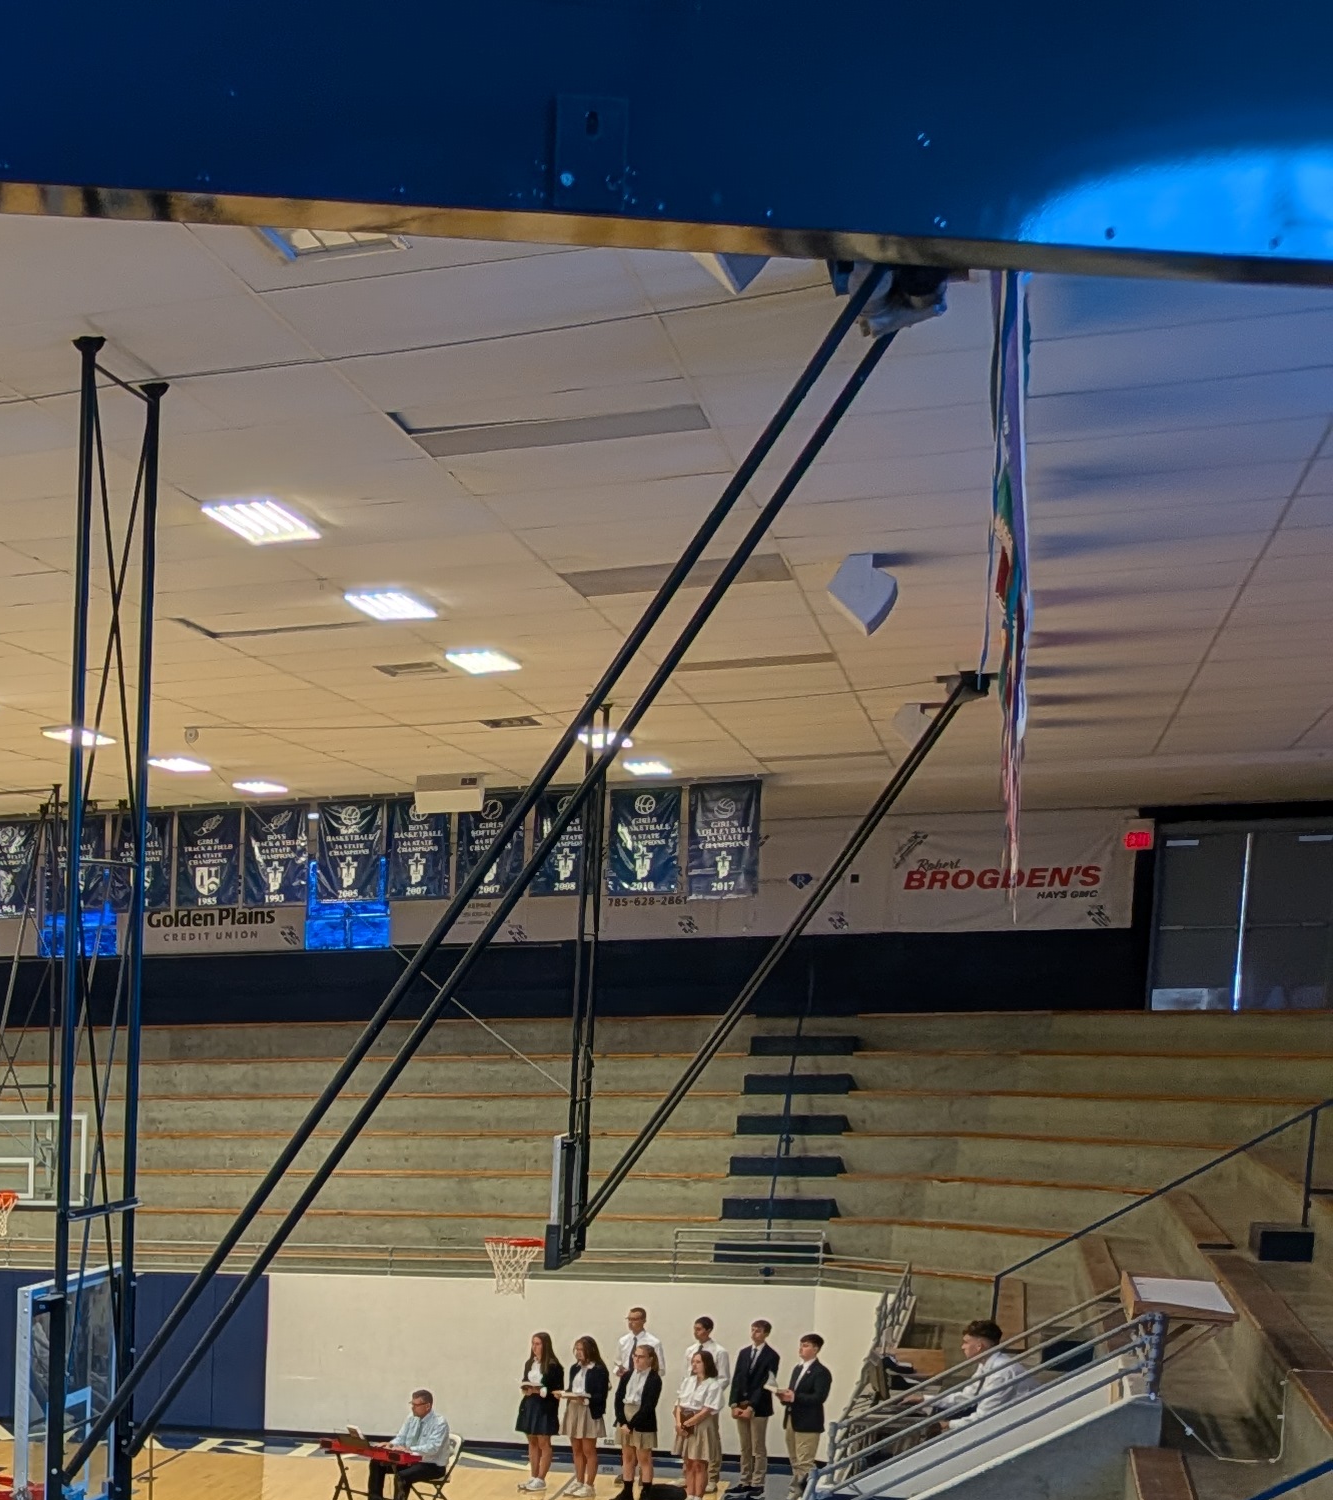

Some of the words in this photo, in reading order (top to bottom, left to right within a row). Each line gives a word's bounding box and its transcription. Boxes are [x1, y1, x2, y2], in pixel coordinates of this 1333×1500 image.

[394, 830, 443, 839] BASKETBALL
[696, 826, 753, 837] VOLLEYBALL
[197, 838, 219, 846] GIRLS
[326, 834, 374, 842] BASKETBALL
[621, 838, 666, 847] CAMPIONS
[698, 840, 750, 849] CHAMPIONS
[329, 849, 369, 857] CHAMPIONS
[189, 858, 227, 866] CHAMPIONS
[916, 858, 962, 873] Robert
[903, 865, 1102, 890] BROGDEN'S
[406, 886, 427, 895] 2007
[478, 885, 501, 895] 2007
[711, 881, 735, 891] 2017
[265, 894, 284, 903] 1993
[1037, 890, 1068, 899] HAYS
[147, 908, 215, 928] Golden
[218, 908, 276, 926] Plains
[163, 931, 210, 942] CREDIT
[216, 930, 258, 940] UNION
